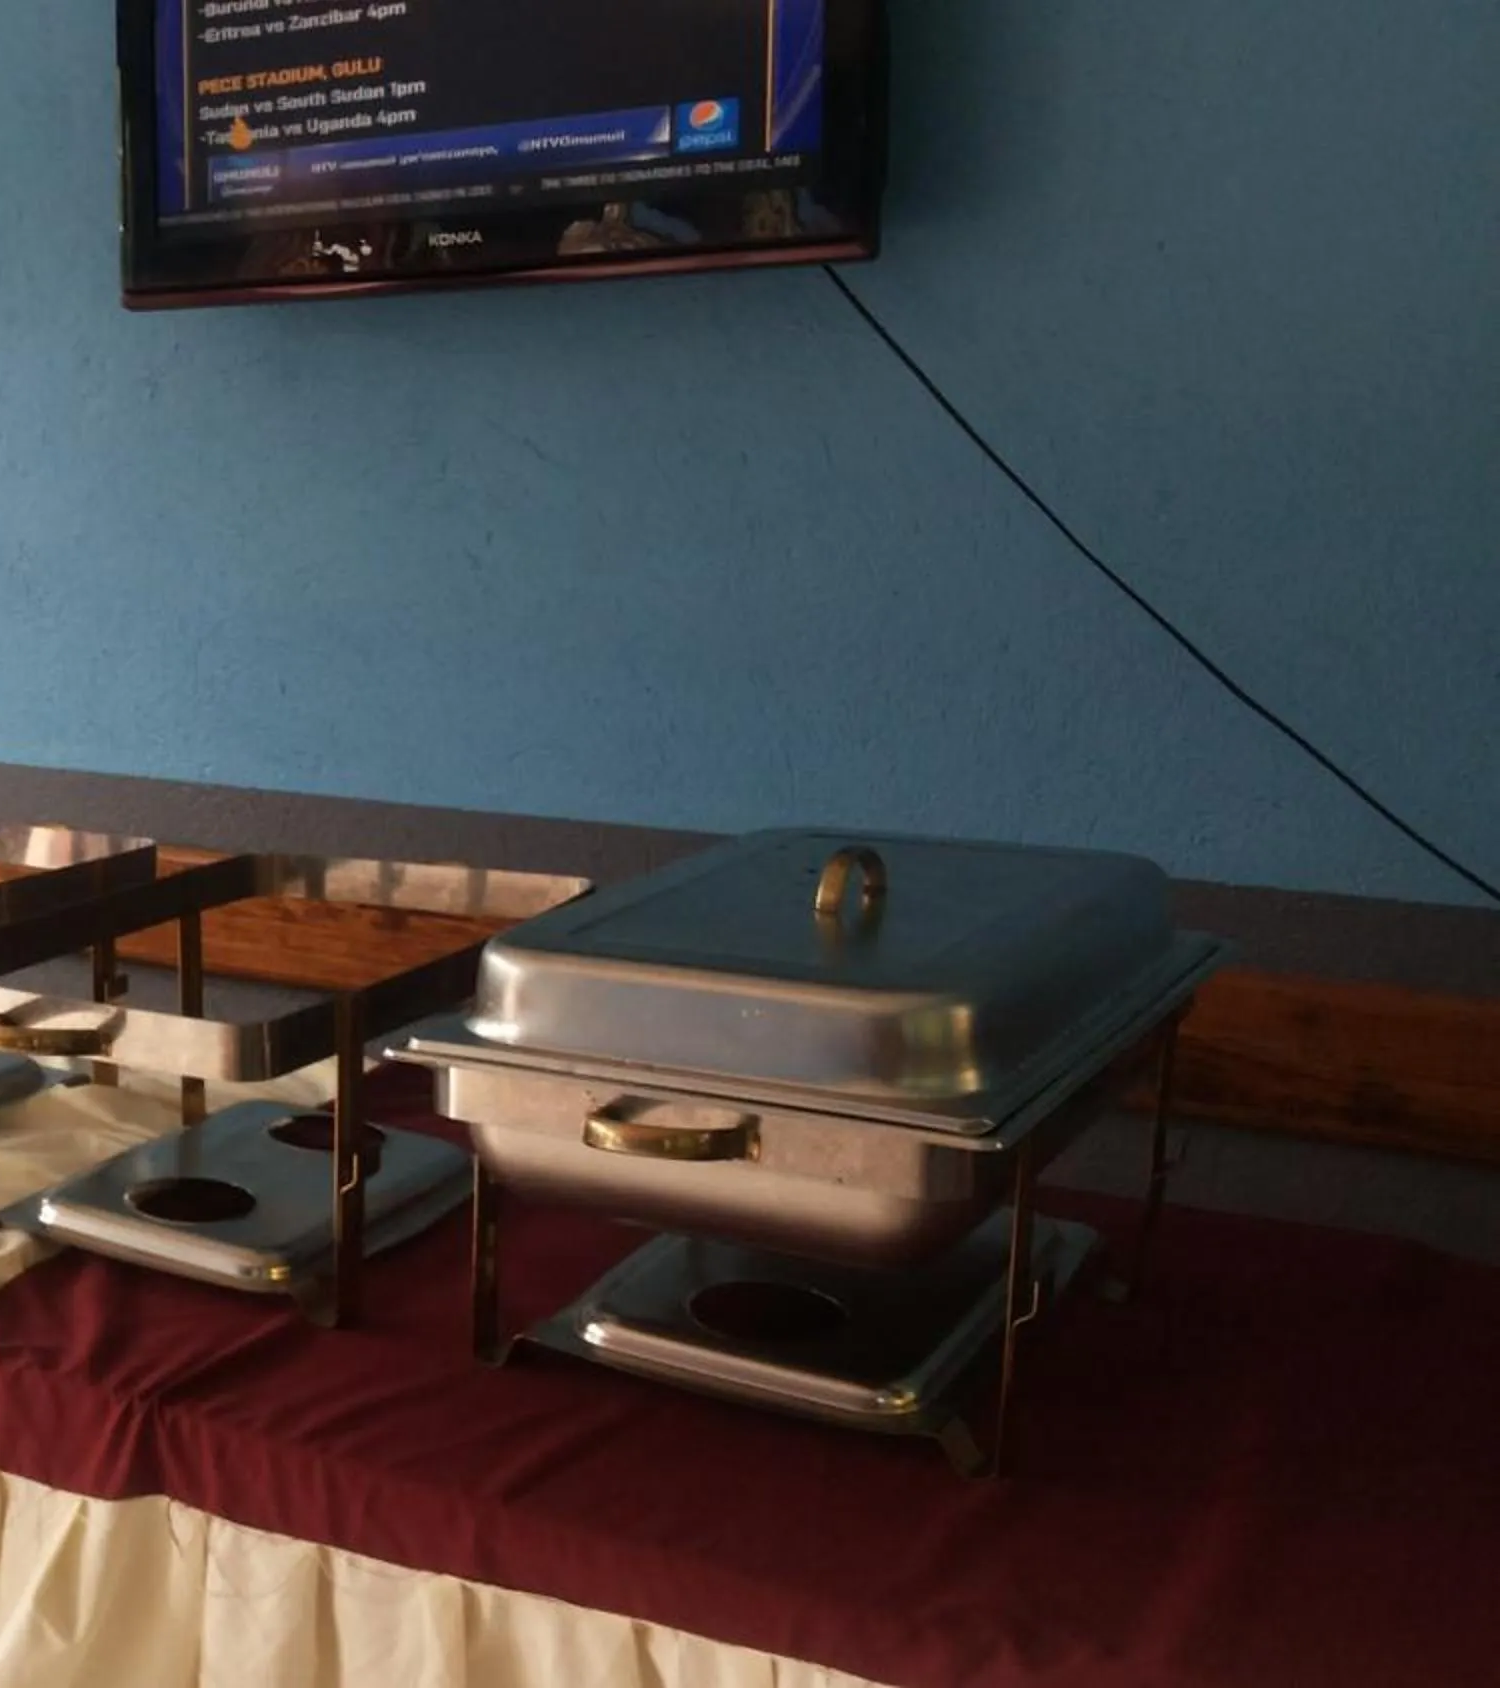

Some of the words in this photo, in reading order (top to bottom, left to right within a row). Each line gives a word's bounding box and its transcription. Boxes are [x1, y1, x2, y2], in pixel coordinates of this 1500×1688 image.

[288, 8, 363, 32] Zanzibar
[366, 2, 406, 20] 4pm
[198, 75, 244, 95] PECE
[249, 65, 328, 90] STADIUM,
[331, 56, 382, 78] GULU
[199, 102, 249, 120] Sudan
[254, 100, 274, 113] vs
[276, 90, 327, 111] South
[330, 83, 385, 104] Sudan
[389, 80, 426, 97] 1pm
[284, 121, 302, 135] vs
[307, 114, 373, 134] Uganda
[376, 108, 417, 127] 4pm
[428, 230, 484, 248] KONKA
